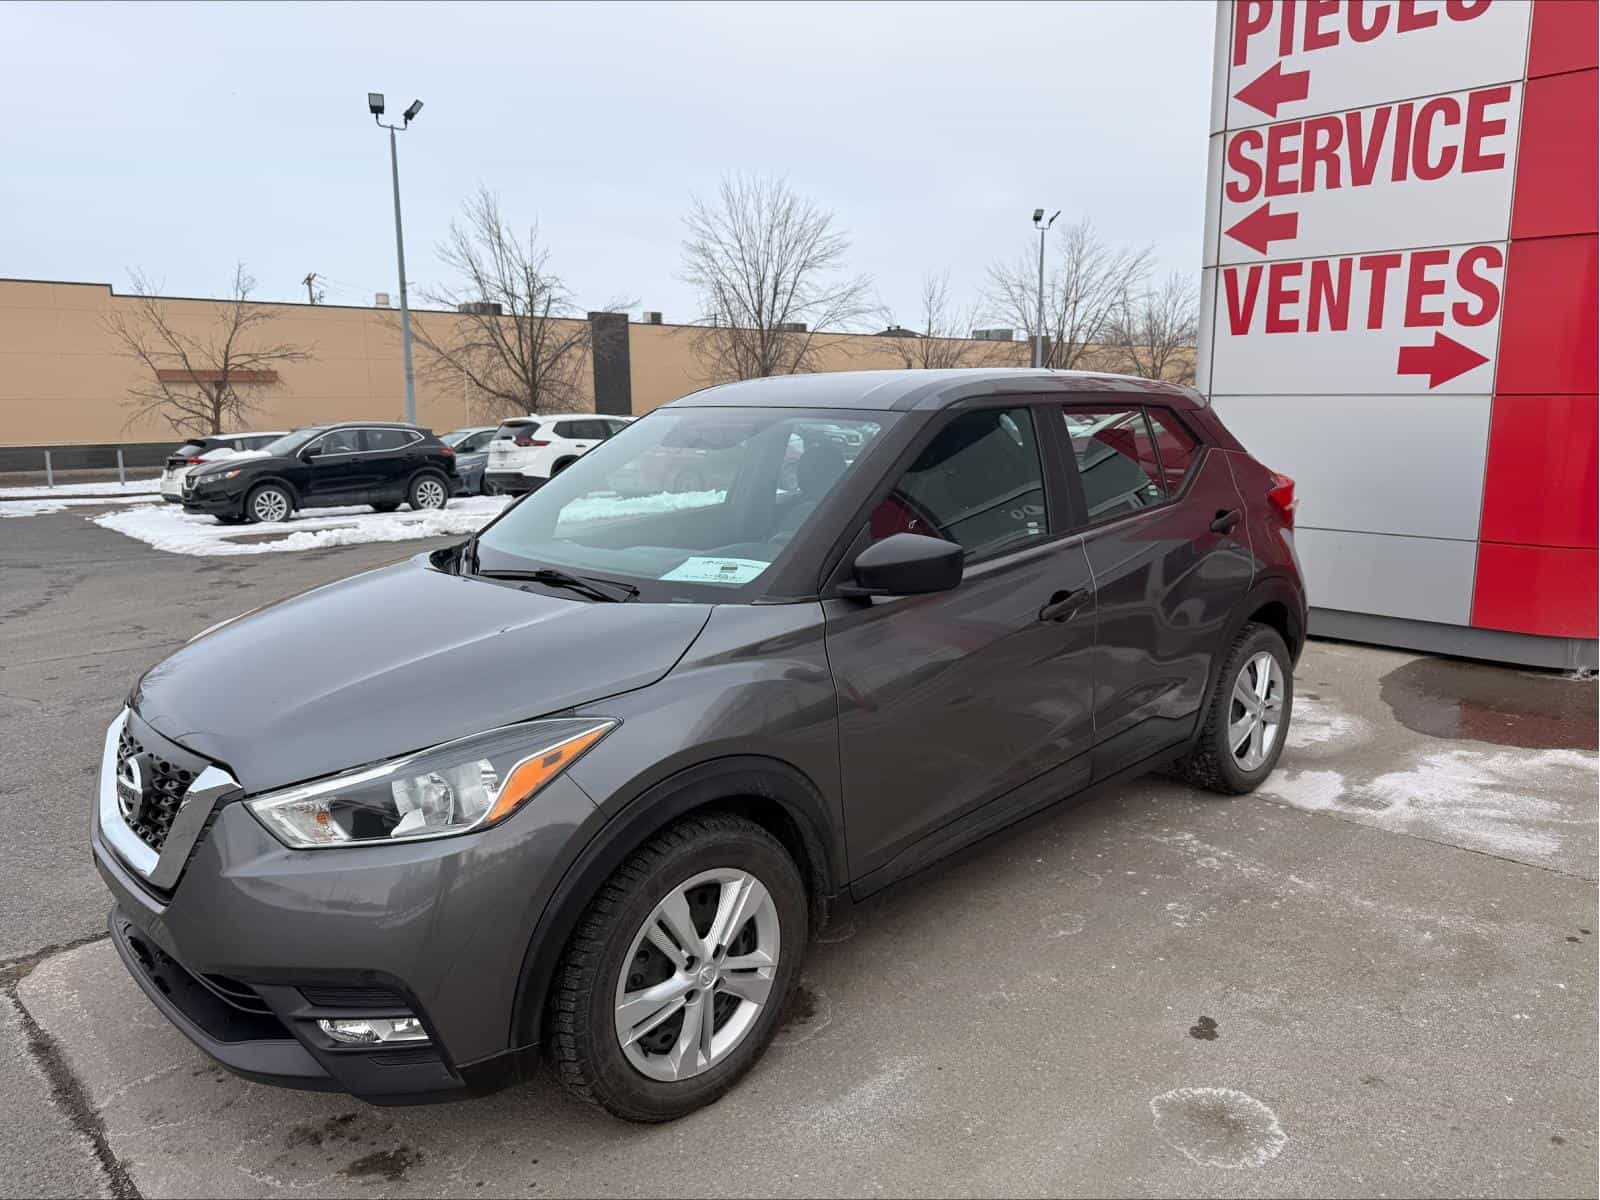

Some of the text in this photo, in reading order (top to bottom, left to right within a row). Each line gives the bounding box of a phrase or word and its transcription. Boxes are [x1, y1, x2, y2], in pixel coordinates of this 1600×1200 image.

[1234, 0, 1491, 65] PIEC
[1226, 87, 1511, 202] SERVICE
[1224, 246, 1503, 336] VENTES
